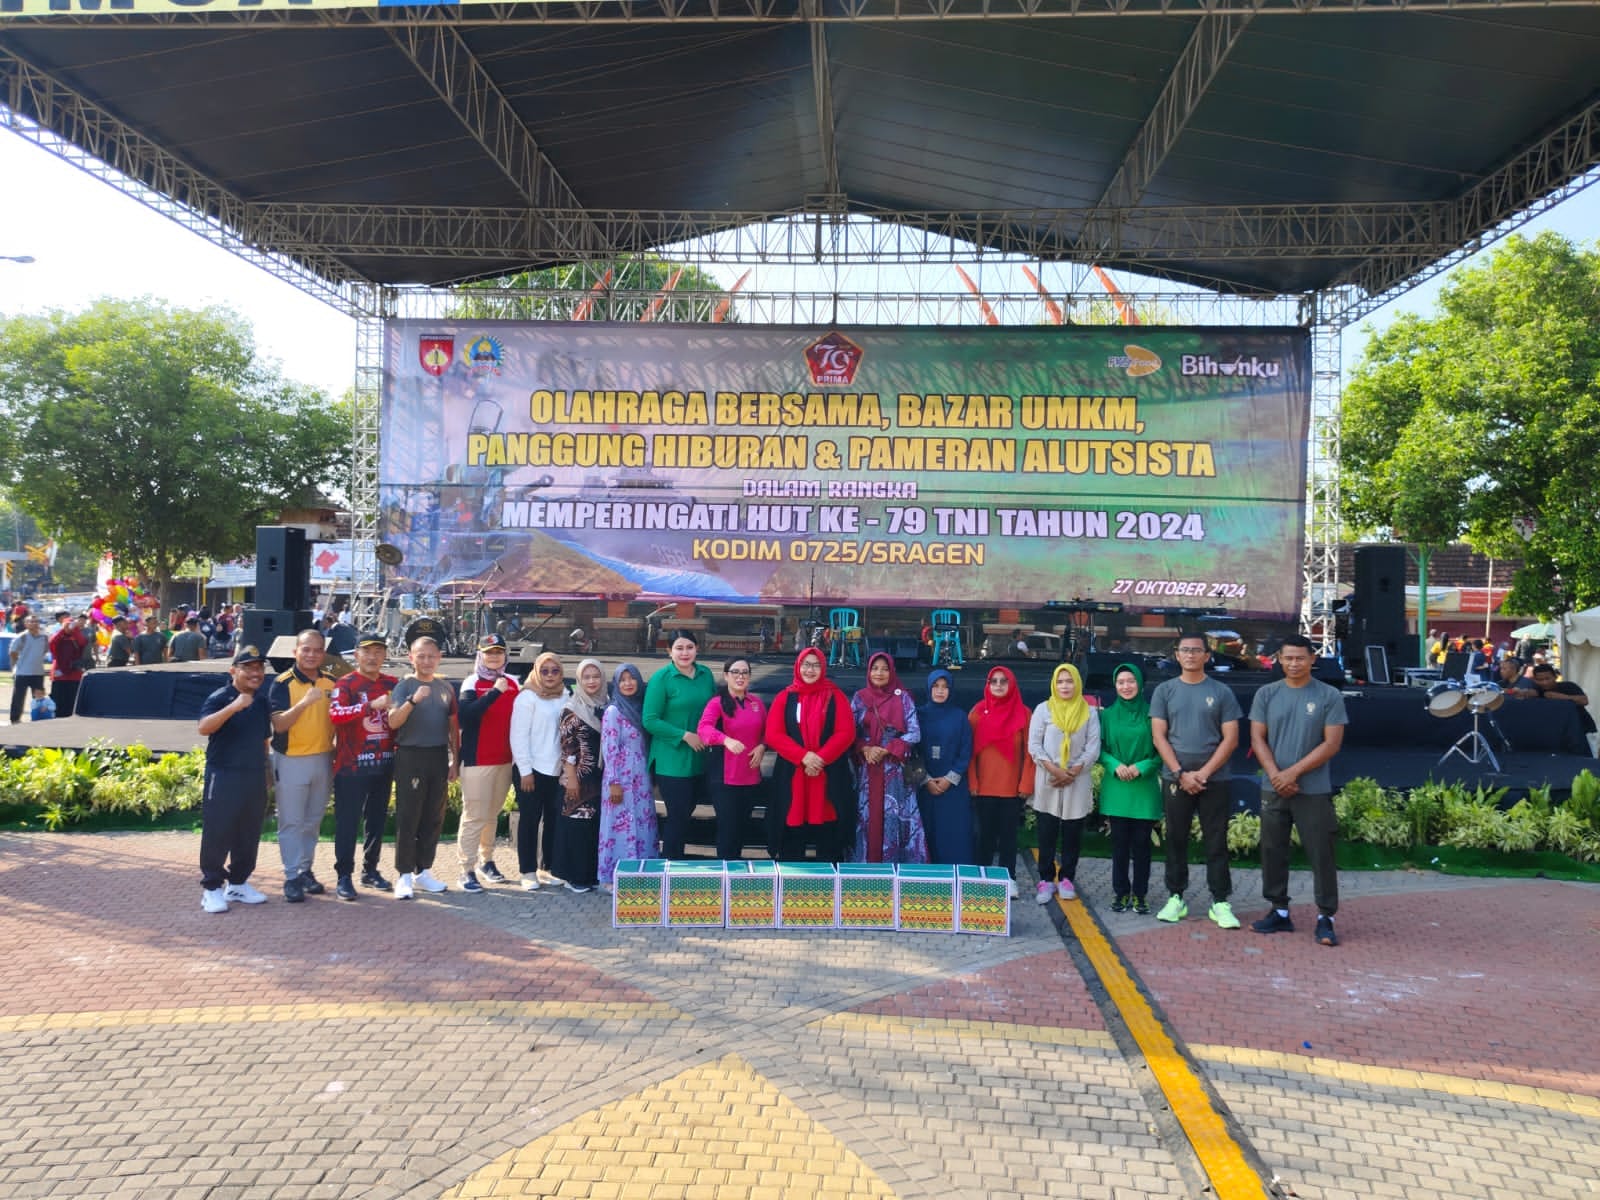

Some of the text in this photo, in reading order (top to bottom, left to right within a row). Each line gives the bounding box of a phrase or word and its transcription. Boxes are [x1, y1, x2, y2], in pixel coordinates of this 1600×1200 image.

[816, 375, 849, 384] PRIMA
[530, 390, 1145, 434] OLAHRAGA BERSAMA, BAZAR UMKM,
[467, 432, 1216, 477] PANGGUNG HIBURAN & PAMERAN ALUTSISTA
[743, 479, 918, 500] DALAM RANGKA
[502, 500, 1205, 541] MEMPERINGATI HUT KE - 79 TNI TAHUN 2024
[693, 538, 985, 565] KODIM 0725/SRAGEN
[1111, 579, 1248, 598] 27 OKTOBER 2024
